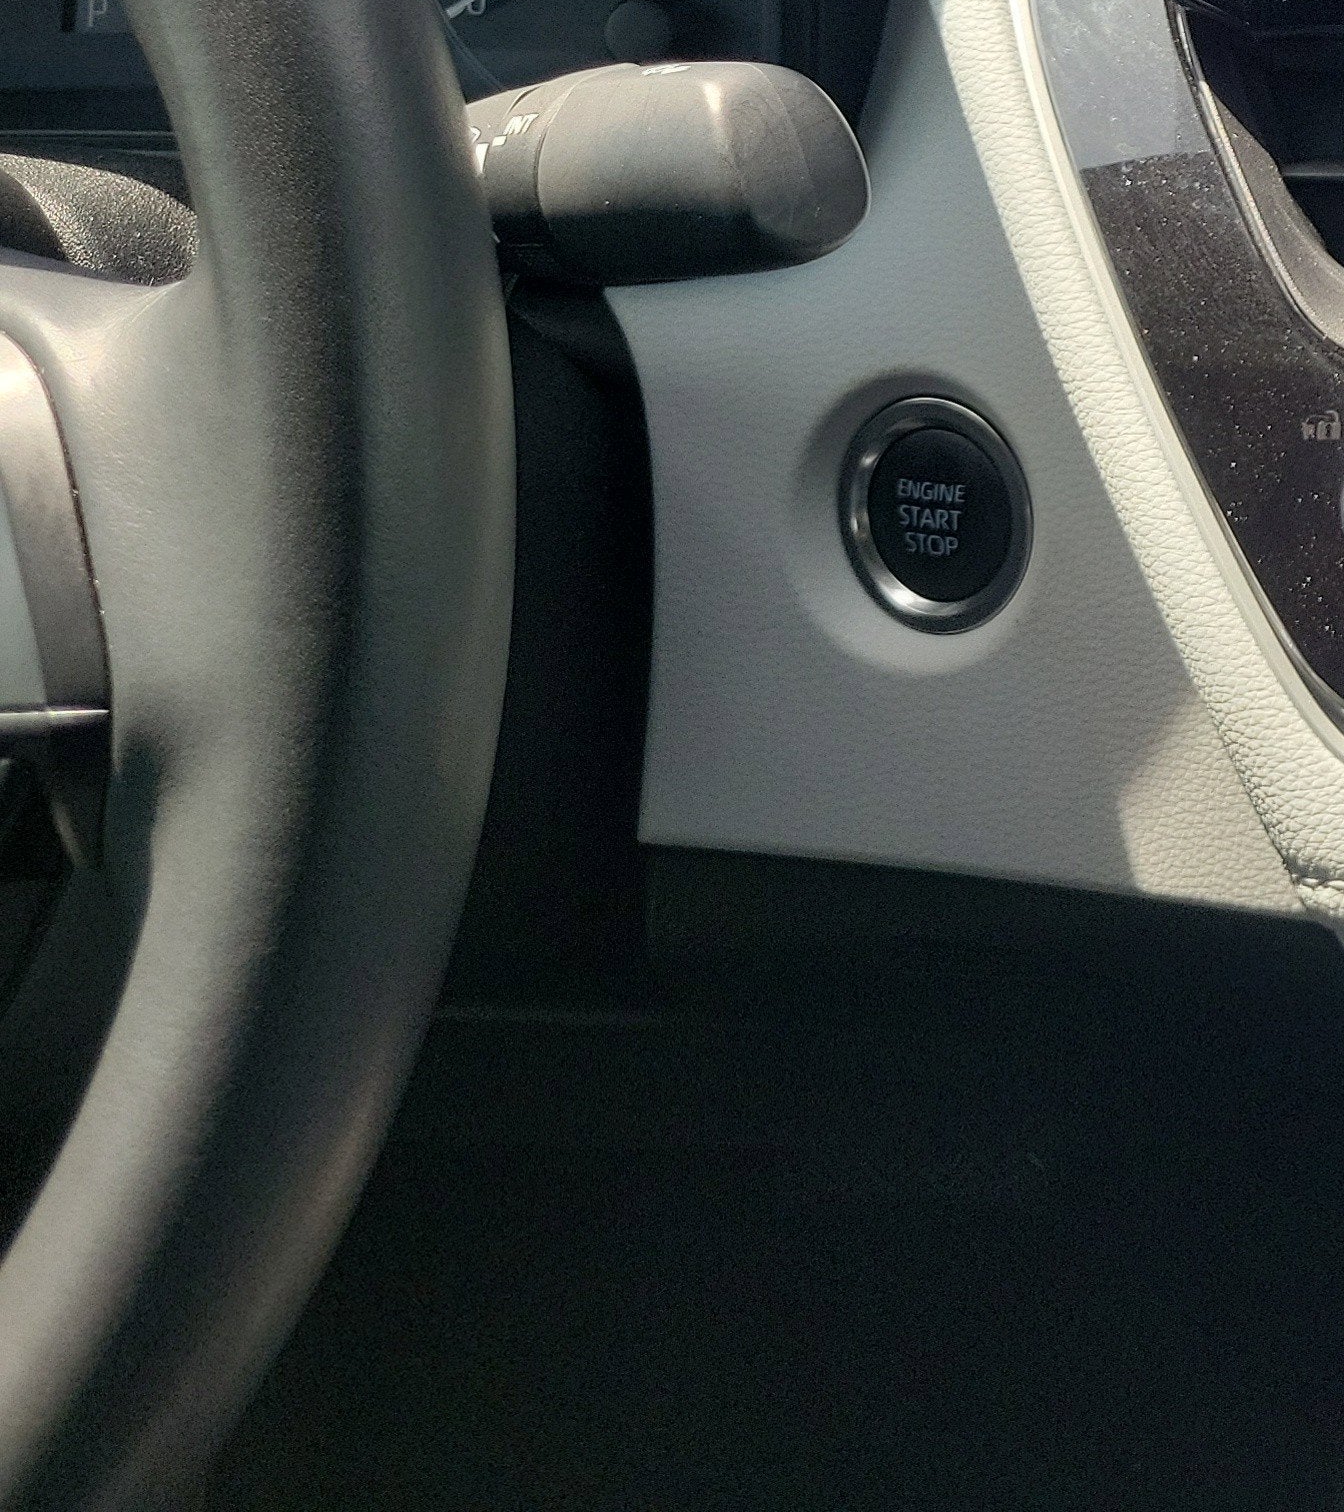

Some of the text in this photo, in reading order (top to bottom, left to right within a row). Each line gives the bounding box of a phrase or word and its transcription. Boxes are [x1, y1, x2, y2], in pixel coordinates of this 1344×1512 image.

[503, 113, 540, 137] INT
[898, 478, 967, 503] ENGINE
[899, 504, 962, 532] START
[905, 531, 959, 557] STOP
